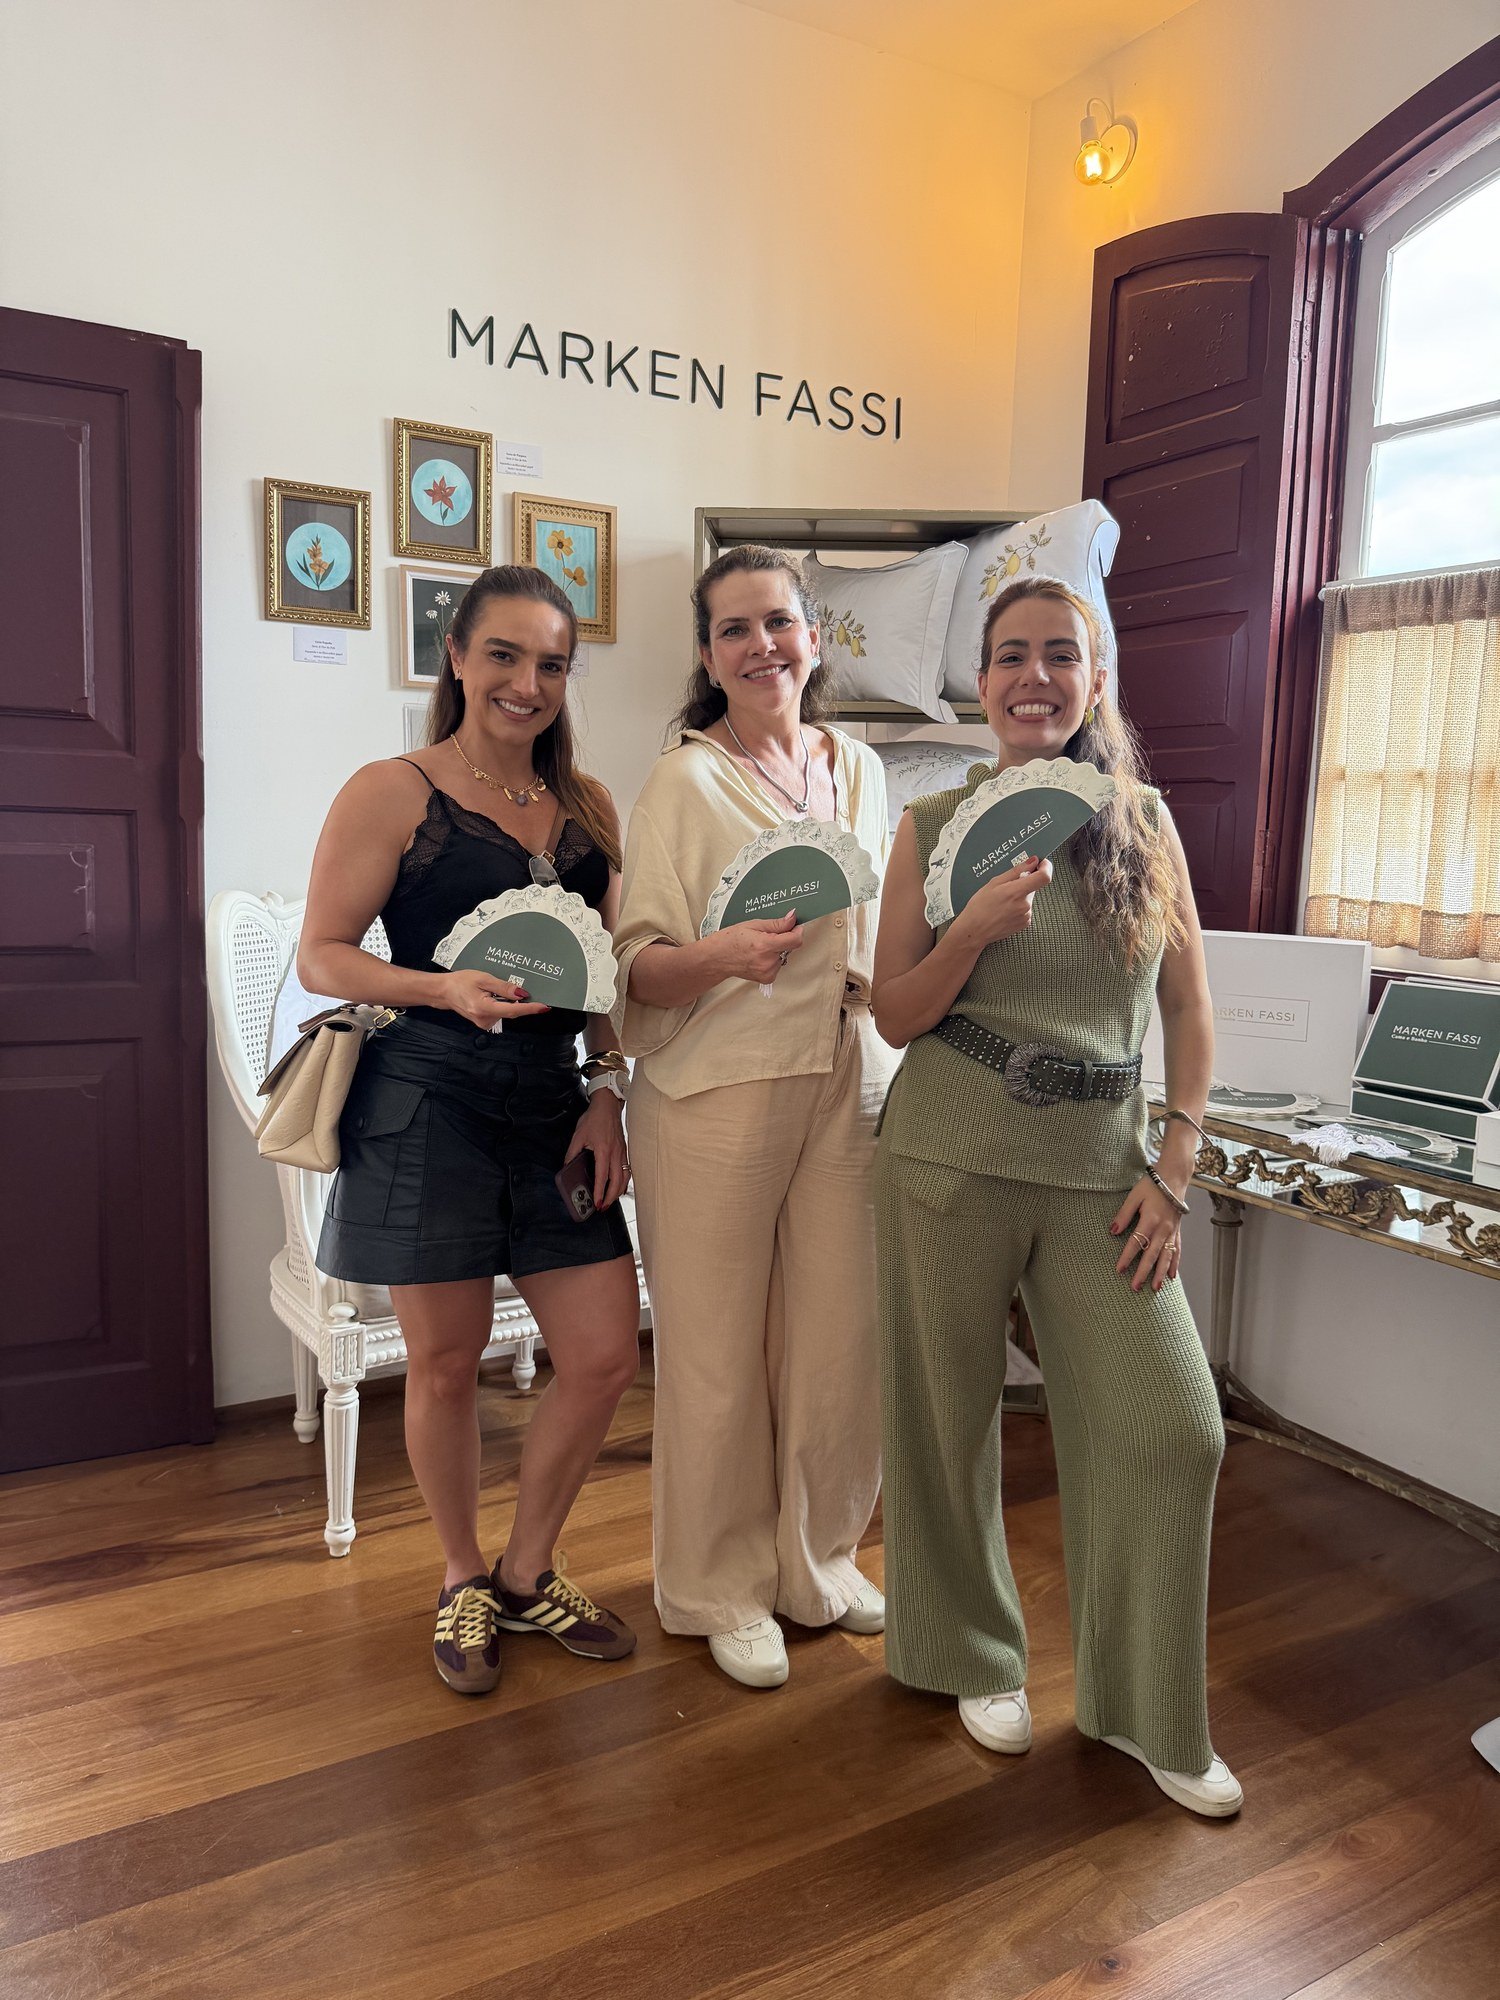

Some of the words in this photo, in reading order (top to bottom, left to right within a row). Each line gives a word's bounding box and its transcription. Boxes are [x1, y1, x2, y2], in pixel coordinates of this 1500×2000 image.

[450, 308, 724, 410] MARKEN
[756, 372, 902, 440] FASSI
[972, 836, 1018, 874] MARKEN
[1019, 811, 1051, 838] FASSI
[745, 888, 787, 908] MARKEN
[790, 880, 820, 895] FASSI
[486, 946, 531, 966] MARKEN
[533, 959, 564, 976] FASSI
[1259, 1010, 1295, 1022] FASSI
[1392, 1025, 1443, 1039] MARKEN
[1446, 1032, 1482, 1045] FASSI
